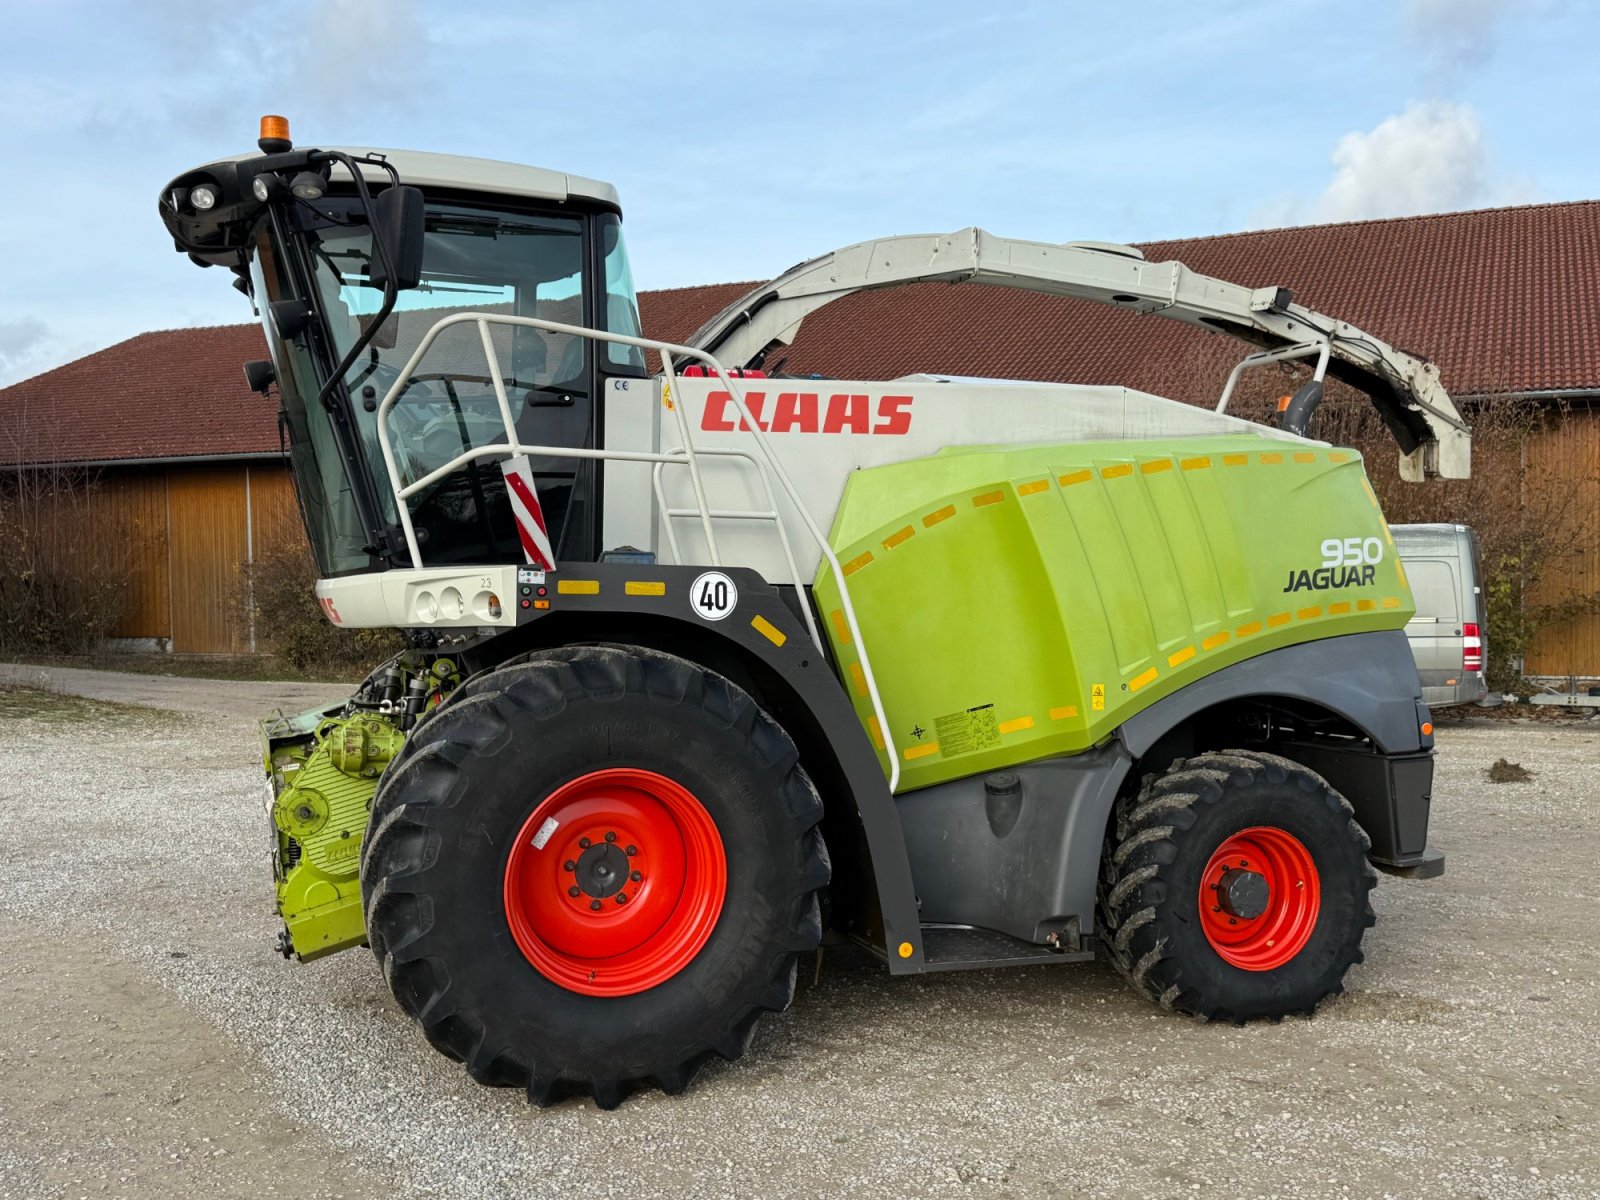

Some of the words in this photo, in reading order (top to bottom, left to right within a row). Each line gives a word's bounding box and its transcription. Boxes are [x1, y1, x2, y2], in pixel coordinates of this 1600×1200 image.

[614, 380, 629, 391] CE
[700, 391, 914, 435] CLAAS
[1320, 536, 1384, 568] 950
[480, 577, 492, 589] 23
[1283, 564, 1376, 593] JAGUAR
[700, 581, 728, 611] 40
